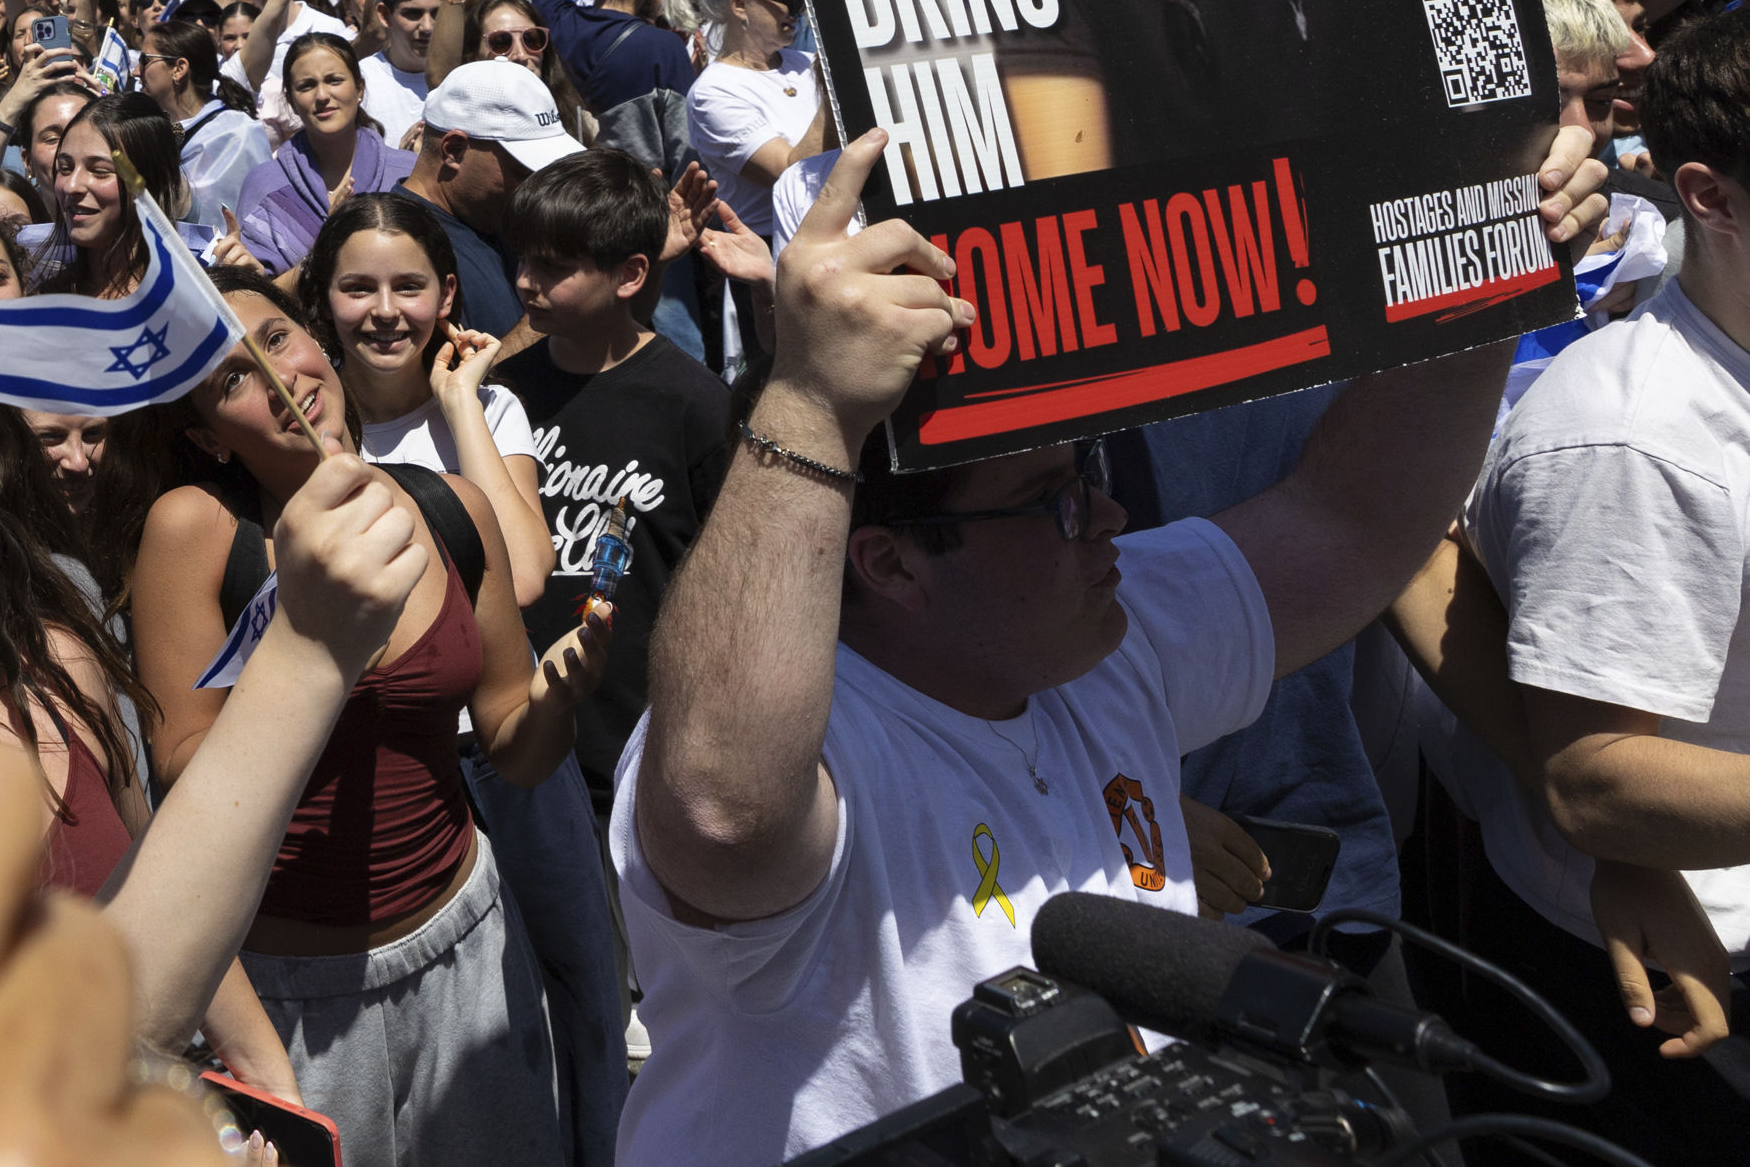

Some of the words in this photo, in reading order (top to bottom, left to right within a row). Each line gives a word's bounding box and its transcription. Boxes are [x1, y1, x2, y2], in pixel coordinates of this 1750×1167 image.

[866, 52, 1024, 206] HIM
[1118, 156, 1318, 338] NOW!
[1369, 190, 1455, 244] HOSTAGES
[1455, 184, 1486, 227] AND
[1378, 229, 1484, 307] FAMILIES
[1482, 214, 1555, 284] FORUM
